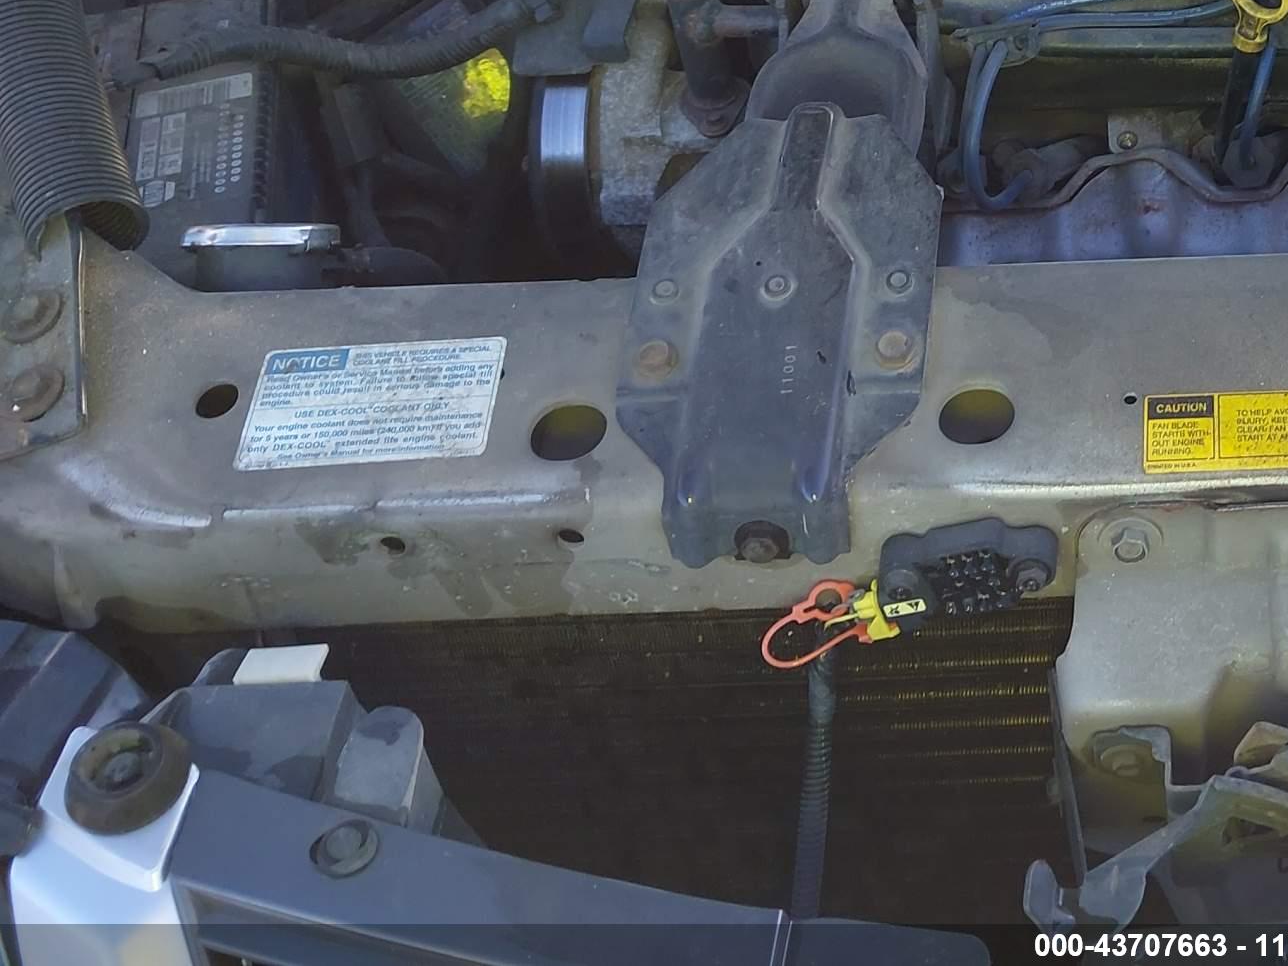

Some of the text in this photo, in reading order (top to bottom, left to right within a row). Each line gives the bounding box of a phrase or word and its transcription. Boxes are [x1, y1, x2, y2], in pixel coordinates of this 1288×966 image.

[408, 347, 450, 356] REQUIRES
[458, 345, 491, 353] SPECIAL
[272, 354, 341, 371] NOTICE
[411, 353, 460, 362] PROCEDURE
[342, 369, 378, 379] Service
[380, 368, 412, 376] Manual
[445, 364, 475, 373] adding
[478, 363, 494, 371] any
[263, 383, 301, 391] coolant
[359, 376, 392, 384] Failure
[442, 371, 476, 380] special
[479, 370, 492, 378] fill
[262, 389, 311, 399] procedure
[313, 387, 340, 396] could
[340, 385, 370, 395] result
[385, 382, 420, 392] serious
[424, 380, 460, 389] damage
[476, 378, 491, 386] the
[294, 409, 314, 418] USE
[373, 402, 420, 413] COOLANT
[423, 401, 450, 411] ONLY
[1156, 402, 1206, 413] CAUTION
[1250, 408, 1272, 416] HELP
[254, 411, 483, 433] Your engine coolant does not require maintenance
[1171, 421, 1199, 429] BLADE
[250, 435, 263, 443] for
[273, 434, 298, 443] years
[314, 430, 348, 439] 150,000
[350, 428, 375, 436] miles
[376, 425, 415, 435] (240,000
[445, 423, 461, 431] you
[463, 421, 481, 429] add
[1152, 430, 1185, 438] STARTS
[1152, 438, 1204, 447] OUT ENGINE
[1237, 434, 1264, 442] START
[1266, 434, 1277, 442] AT
[247, 445, 268, 454] only
[335, 437, 380, 447] extended
[384, 436, 399, 444] life
[403, 434, 436, 443] engine
[330, 448, 361, 457] Manual
[362, 447, 374, 455] for
[375, 446, 396, 454] more
